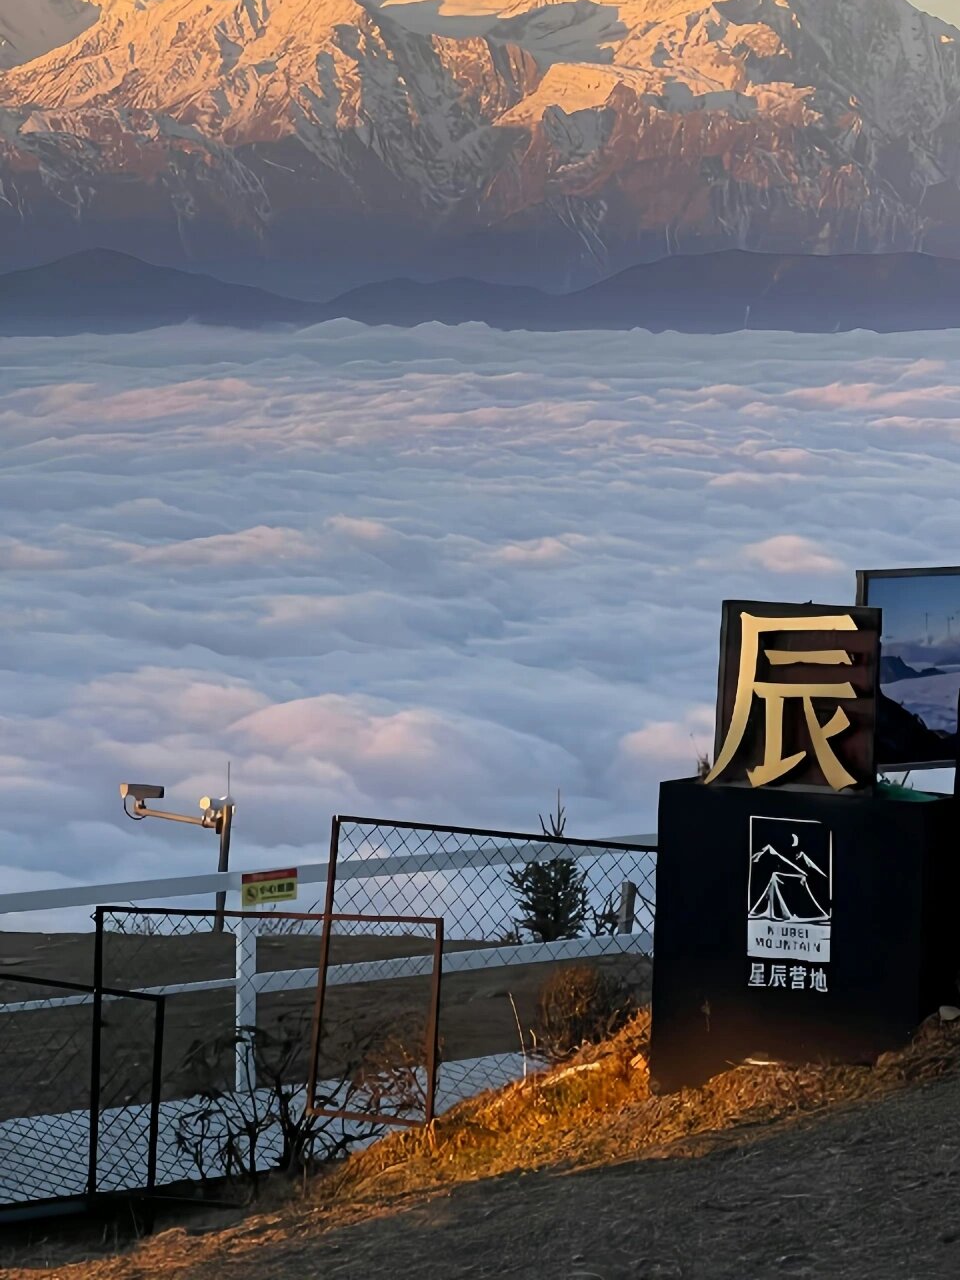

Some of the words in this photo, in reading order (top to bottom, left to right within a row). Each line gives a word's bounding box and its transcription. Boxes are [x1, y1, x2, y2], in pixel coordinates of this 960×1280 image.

[704, 611, 858, 791] 辰
[767, 925, 809, 939] NUBEI
[747, 962, 829, 993] 星辰营地
